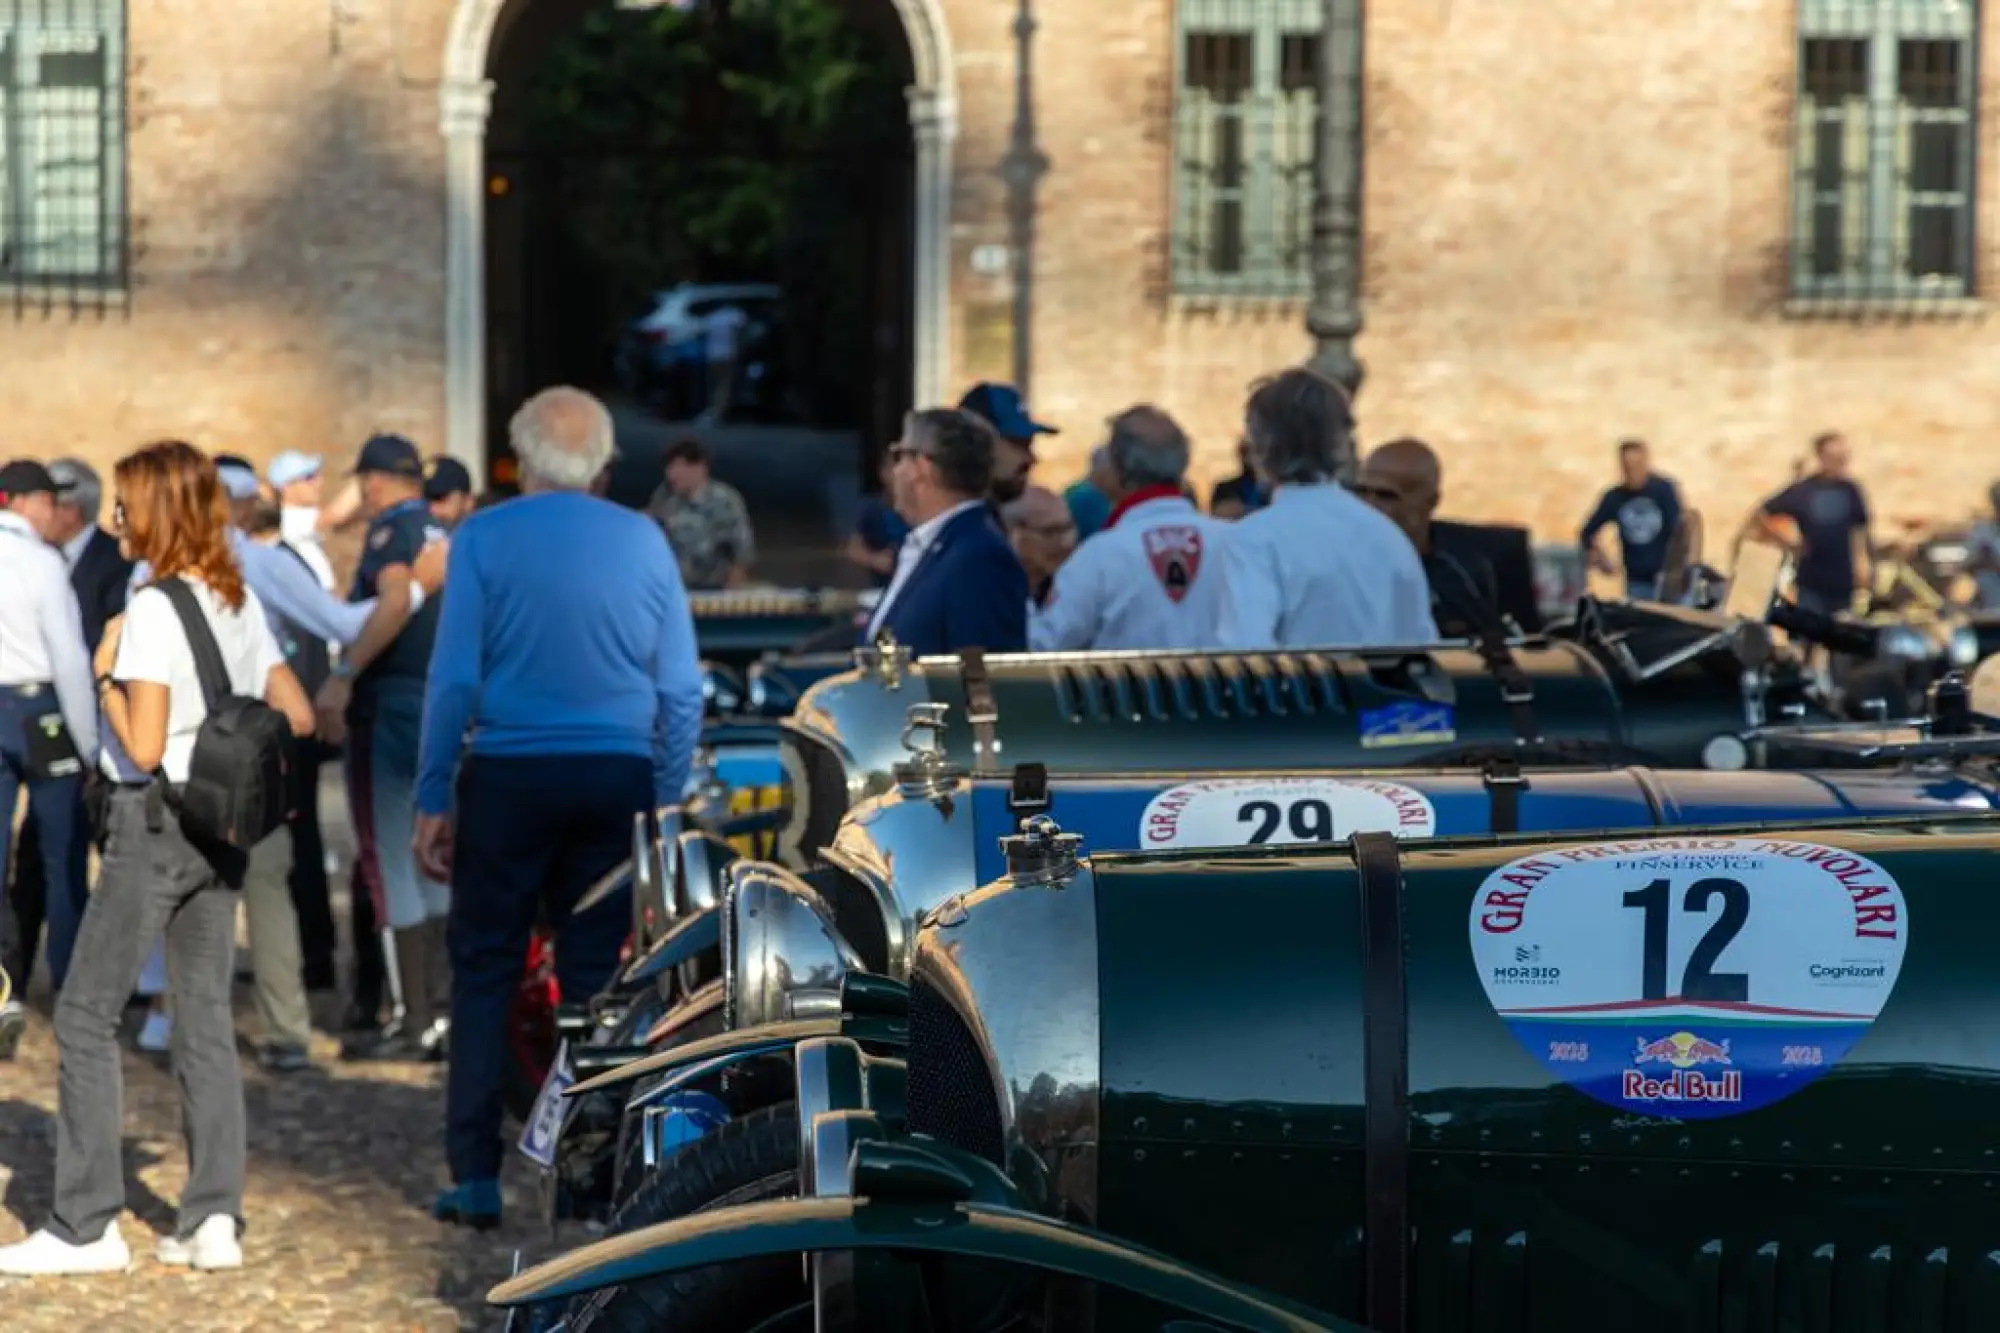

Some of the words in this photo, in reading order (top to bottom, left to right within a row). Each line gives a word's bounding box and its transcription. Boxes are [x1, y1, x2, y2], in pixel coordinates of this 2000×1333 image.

[1148, 791, 1196, 842] GRAN
[1236, 798, 1334, 845] 29
[1615, 860, 1764, 870] FINSERVICE
[1480, 859, 1563, 934] GRAN
[1559, 840, 1737, 862] PREMIO
[1752, 841, 1898, 940] NUVOLARI
[1622, 877, 1751, 1002] 12
[1810, 964, 1886, 978] Cognizant
[1623, 1069, 1682, 1100] Red
[1684, 1070, 1741, 1101] Bull
